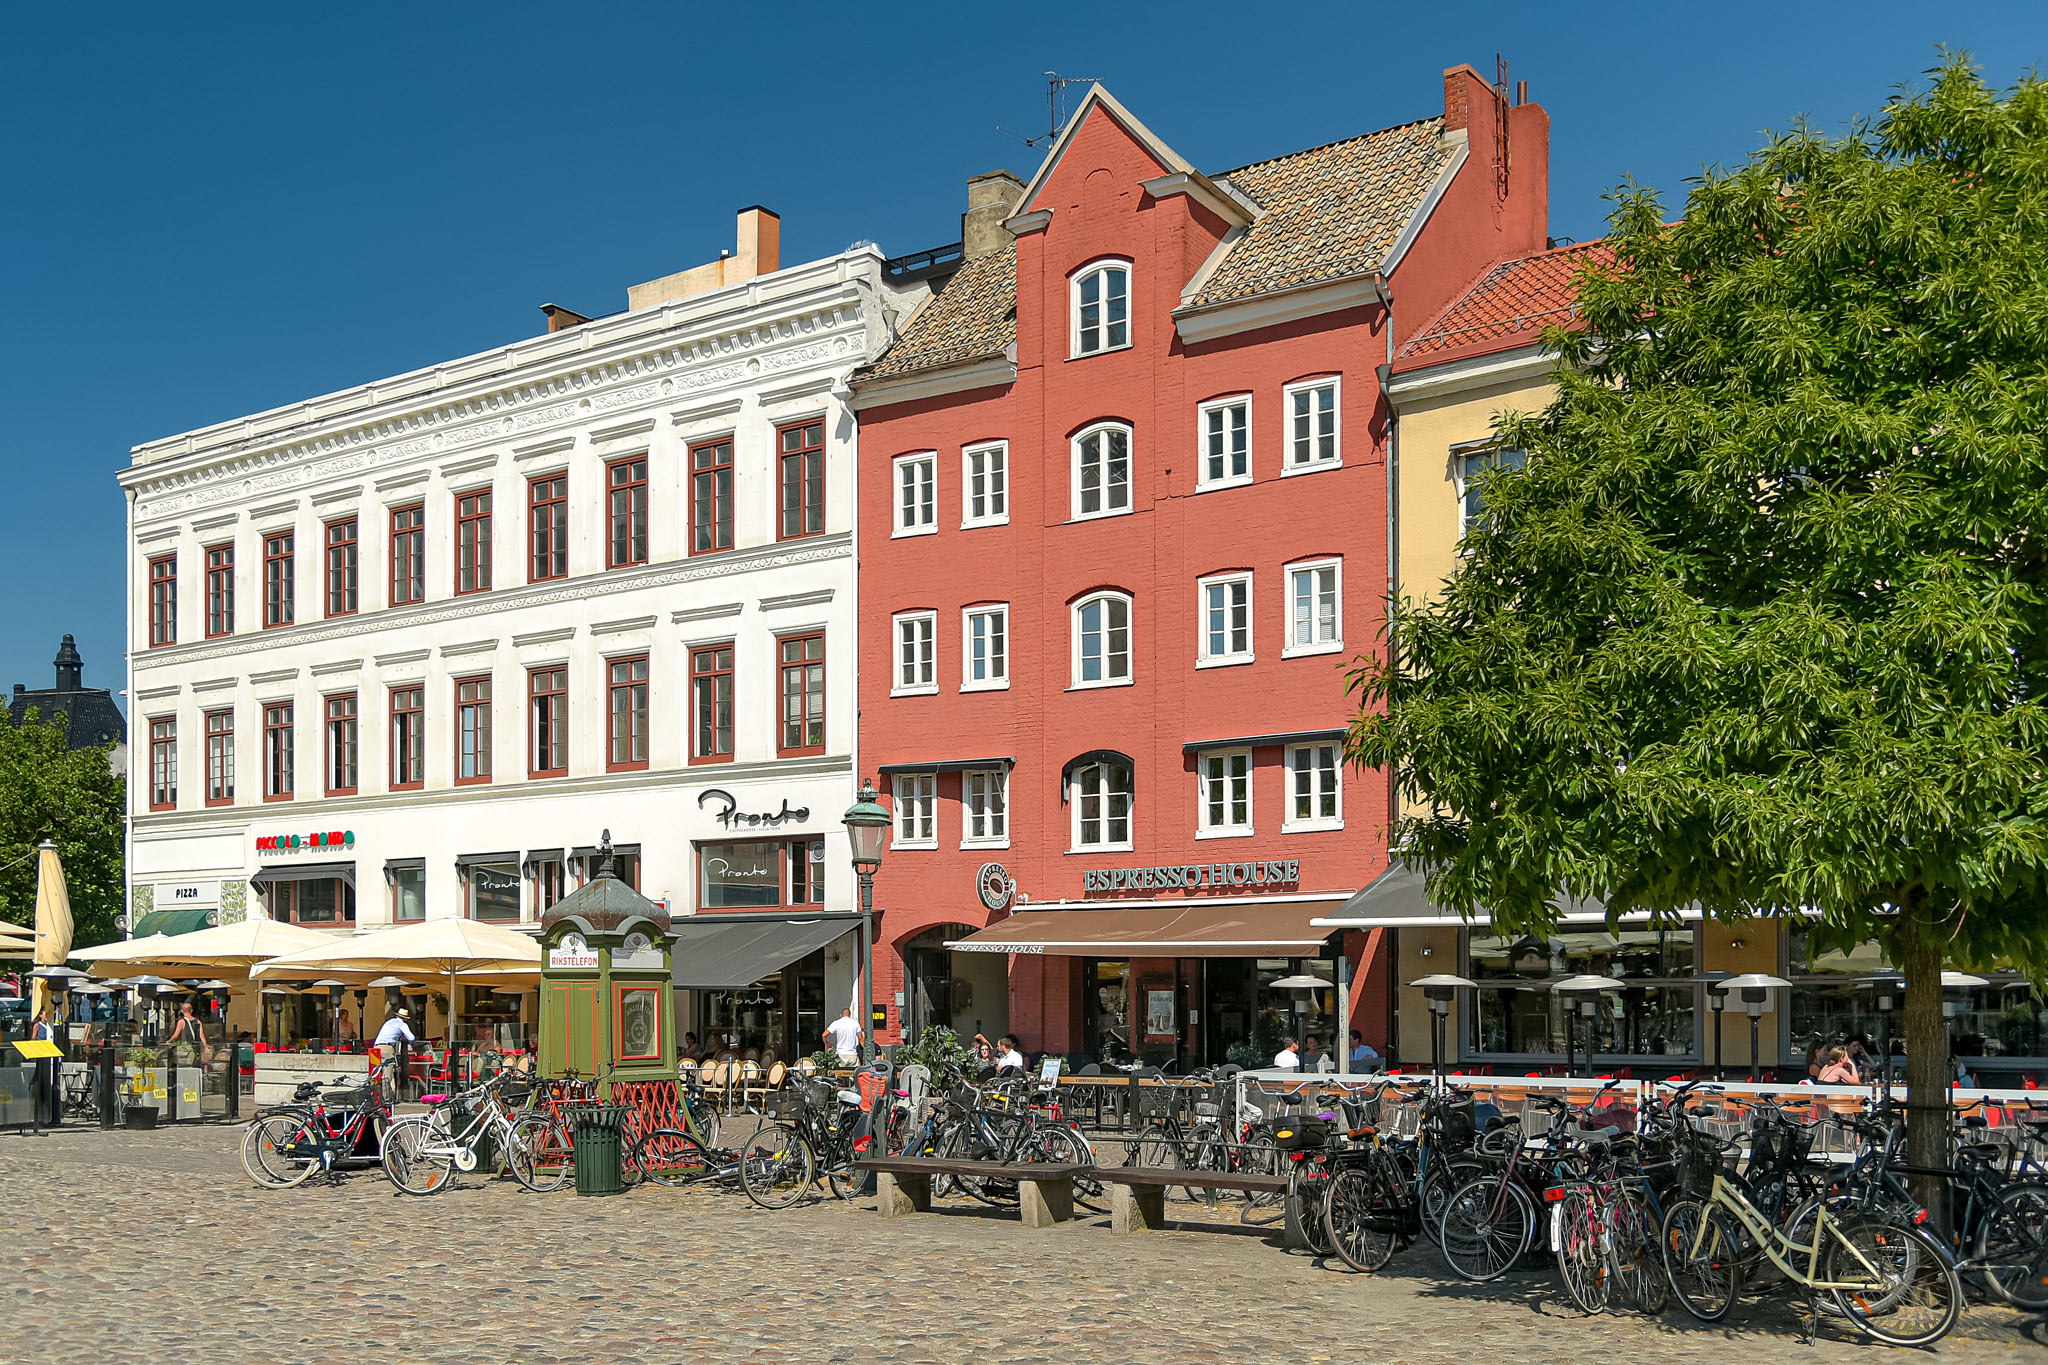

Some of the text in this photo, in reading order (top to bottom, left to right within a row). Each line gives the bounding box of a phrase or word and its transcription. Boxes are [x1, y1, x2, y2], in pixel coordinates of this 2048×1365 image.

[698, 789, 810, 828] Pronto
[256, 834, 300, 850] PICCOLO
[310, 830, 355, 847] MONDO
[708, 858, 768, 878] Pronto
[984, 865, 1009, 882] ESPRESSO
[1083, 859, 1299, 891] ESPRESSO HOUSE
[176, 888, 198, 898] PIZZA
[986, 892, 1008, 907] HOUSE
[953, 945, 1045, 954] ESPRESSO HOUSE
[551, 957, 598, 966] RIKSTELEFON
